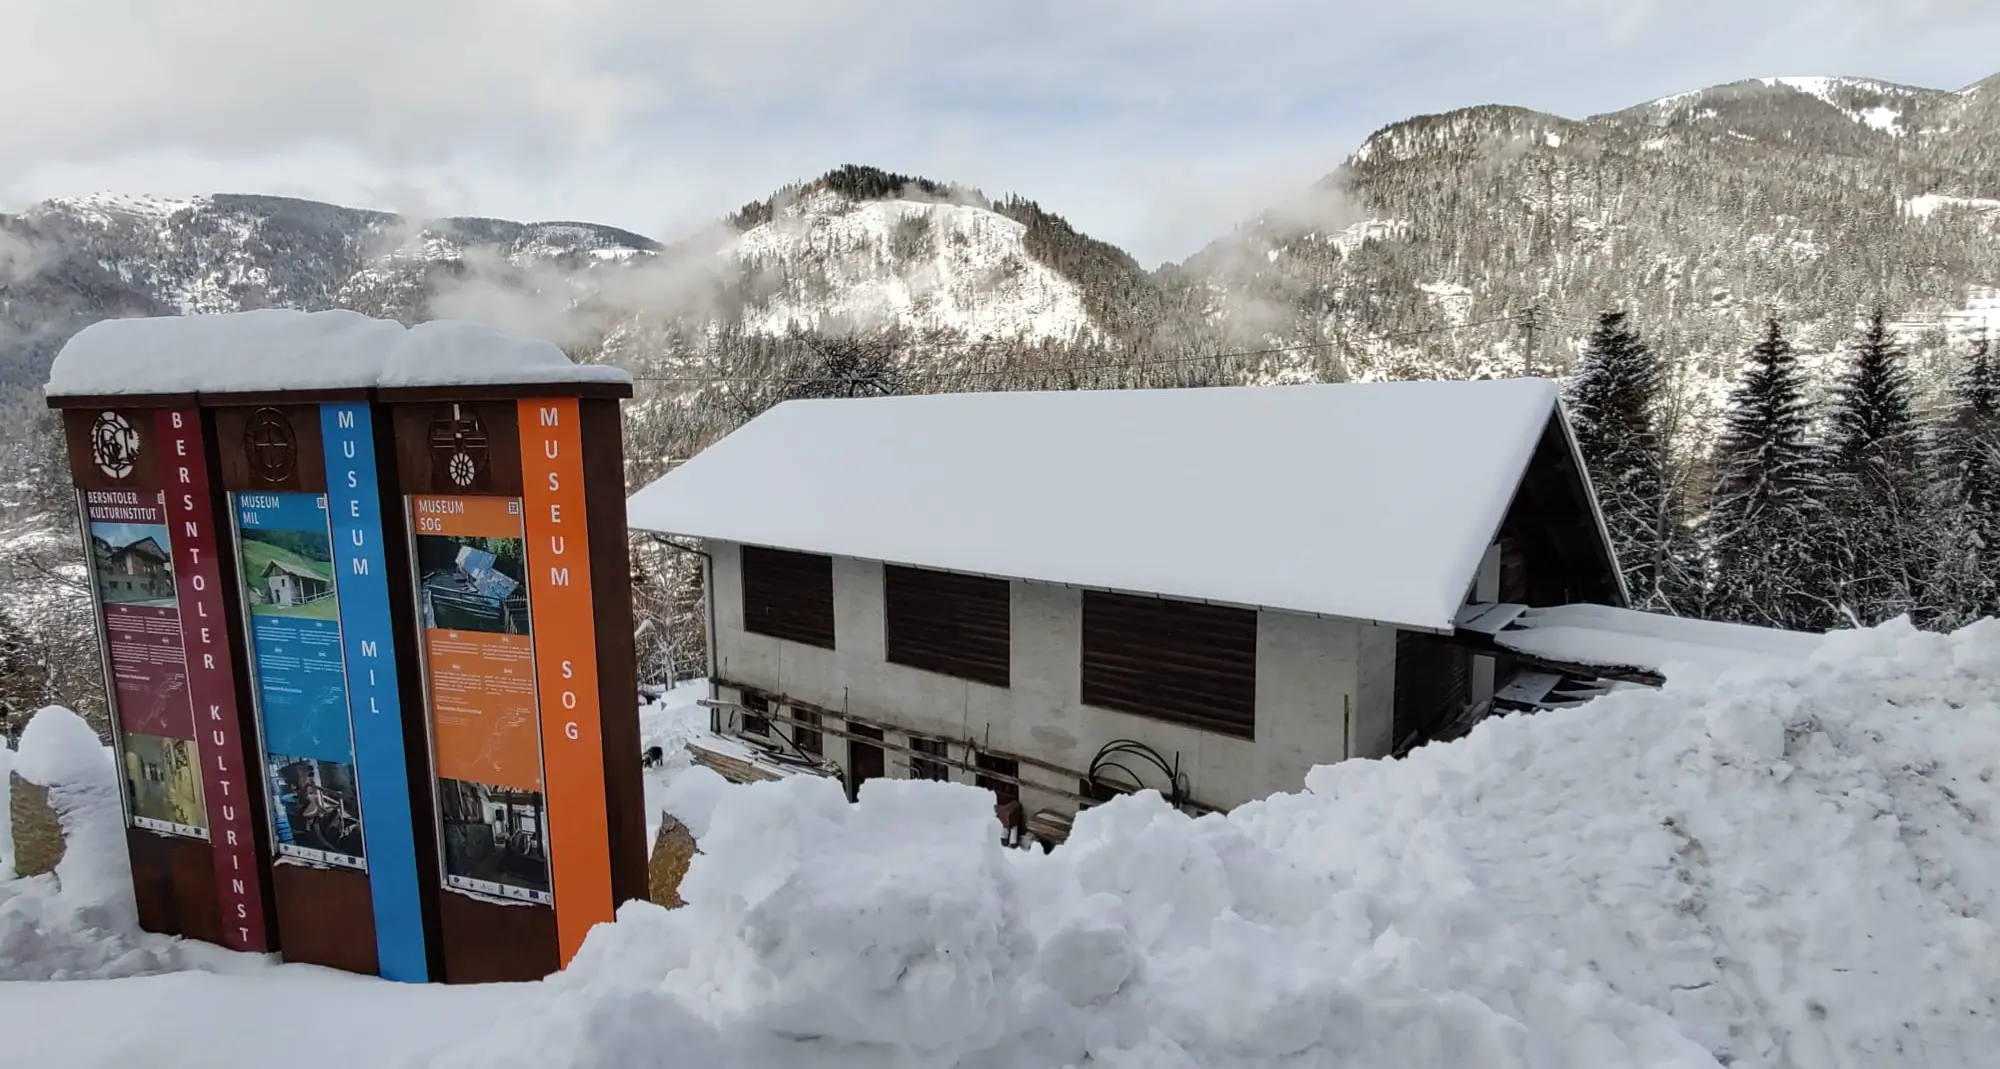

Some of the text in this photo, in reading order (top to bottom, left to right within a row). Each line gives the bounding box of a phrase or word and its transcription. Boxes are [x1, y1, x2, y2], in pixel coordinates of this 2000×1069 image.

[87, 491, 138, 505] BERSNTOLER
[241, 495, 280, 509] MUSEUM
[90, 507, 156, 520] KULTURINSTITUT
[419, 500, 464, 514] MUSEUM
[243, 511, 260, 524] MIL
[420, 517, 442, 531] SOG
[338, 410, 379, 714] MUSEUM MIL
[540, 407, 579, 739] MUSEUM SOG
[172, 412, 249, 942] BERSNTOLER KULTURINST
